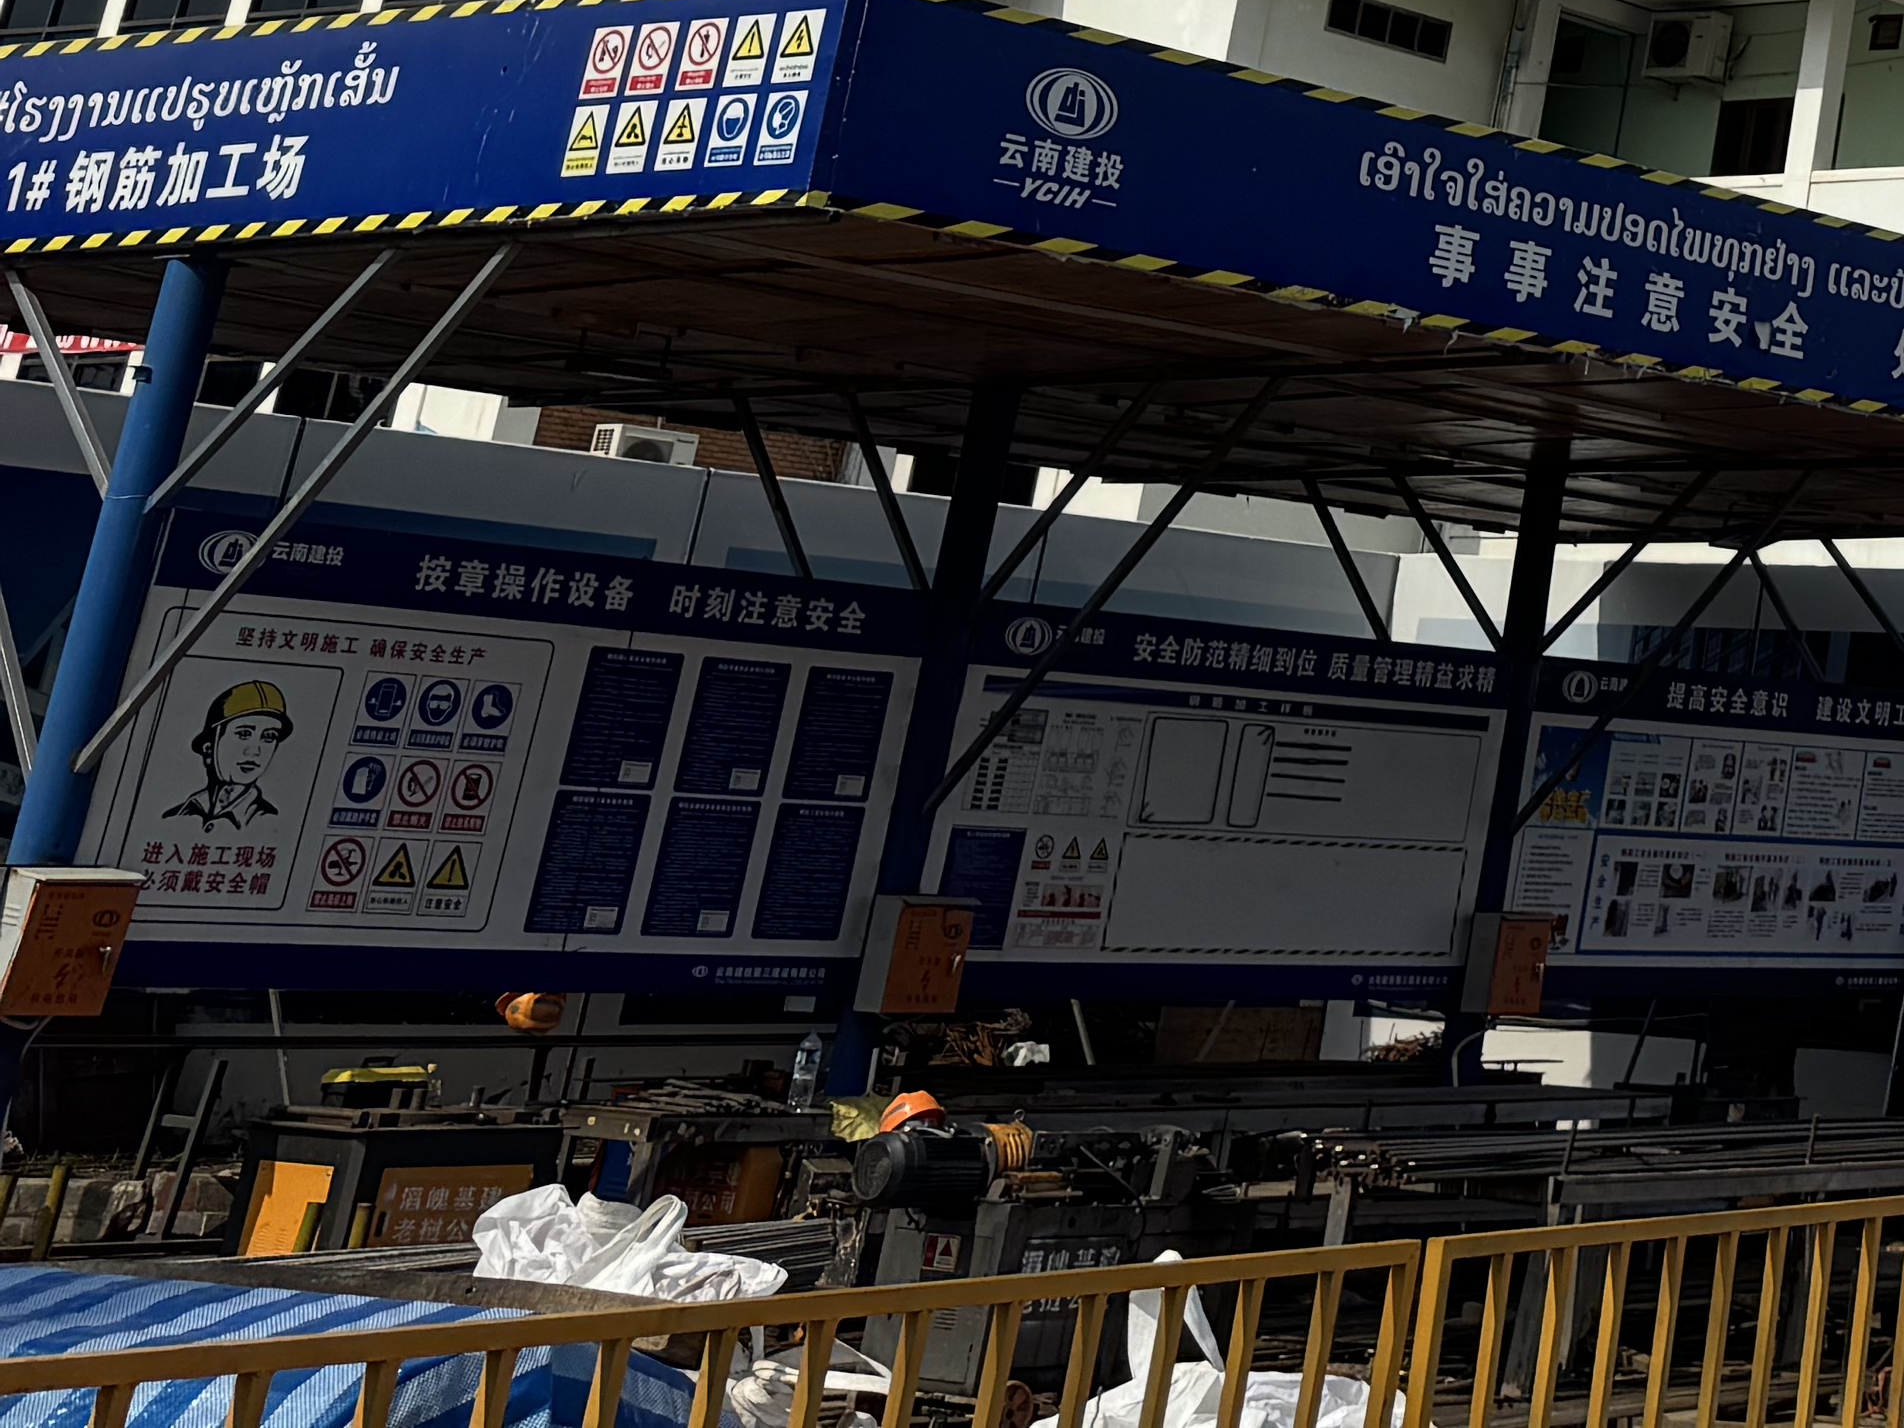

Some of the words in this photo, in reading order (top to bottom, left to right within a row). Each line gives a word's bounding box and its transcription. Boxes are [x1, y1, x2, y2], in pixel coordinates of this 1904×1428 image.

[7, 160, 54, 213] 1#
[65, 134, 309, 215] 钢筋加工场
[999, 134, 1124, 191] 云南建投
[1020, 177, 1091, 210] YCIH
[1430, 224, 1807, 359] 事事注意安全
[272, 541, 345, 567] 云南建投
[415, 554, 635, 612] 按章操作设备
[668, 583, 867, 635] 时刻注意安全
[235, 625, 361, 655] 坚持文明施工
[369, 637, 489, 666] 确保安全生产
[1132, 632, 1319, 678] 安全防范精细到位
[1327, 661, 1498, 695] 质量管理精益求精
[1667, 680, 1792, 719] 提高安全意识
[141, 841, 278, 870] 进入施工现场
[138, 869, 270, 896] 必须戴安全帽
[424, 898, 463, 911] 注意安全
